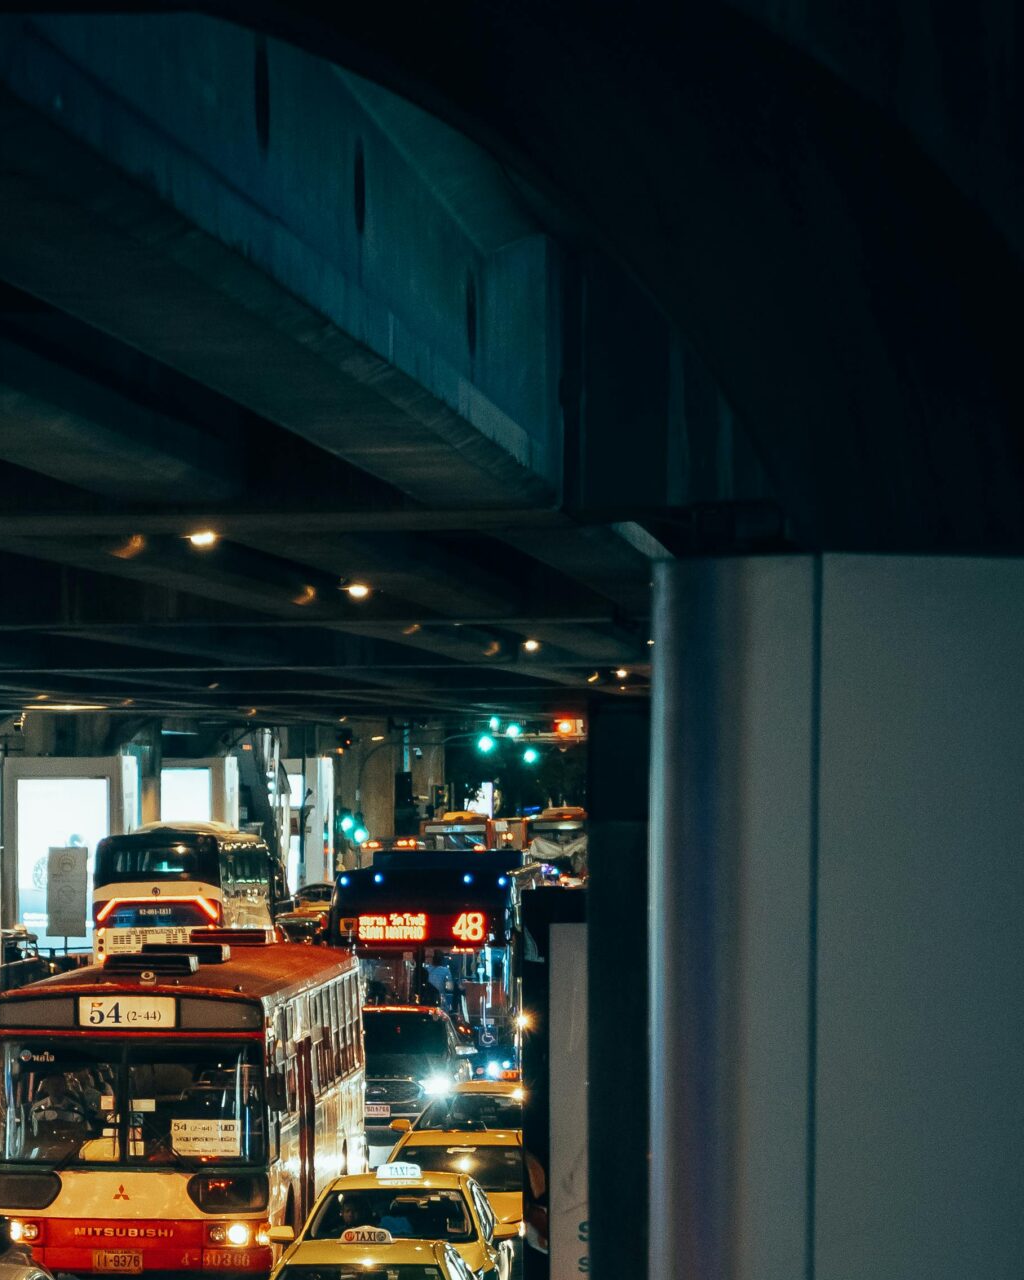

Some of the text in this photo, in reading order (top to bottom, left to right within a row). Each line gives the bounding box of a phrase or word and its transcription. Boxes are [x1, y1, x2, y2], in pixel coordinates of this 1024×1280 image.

[452, 912, 484, 941] 48
[89, 1002, 162, 1025] 54 (2-44)
[174, 1123, 187, 1132] 54
[389, 1166, 408, 1176] TAXI
[74, 1227, 174, 1238] MITSUBISHI
[355, 1231, 376, 1241] TAXI
